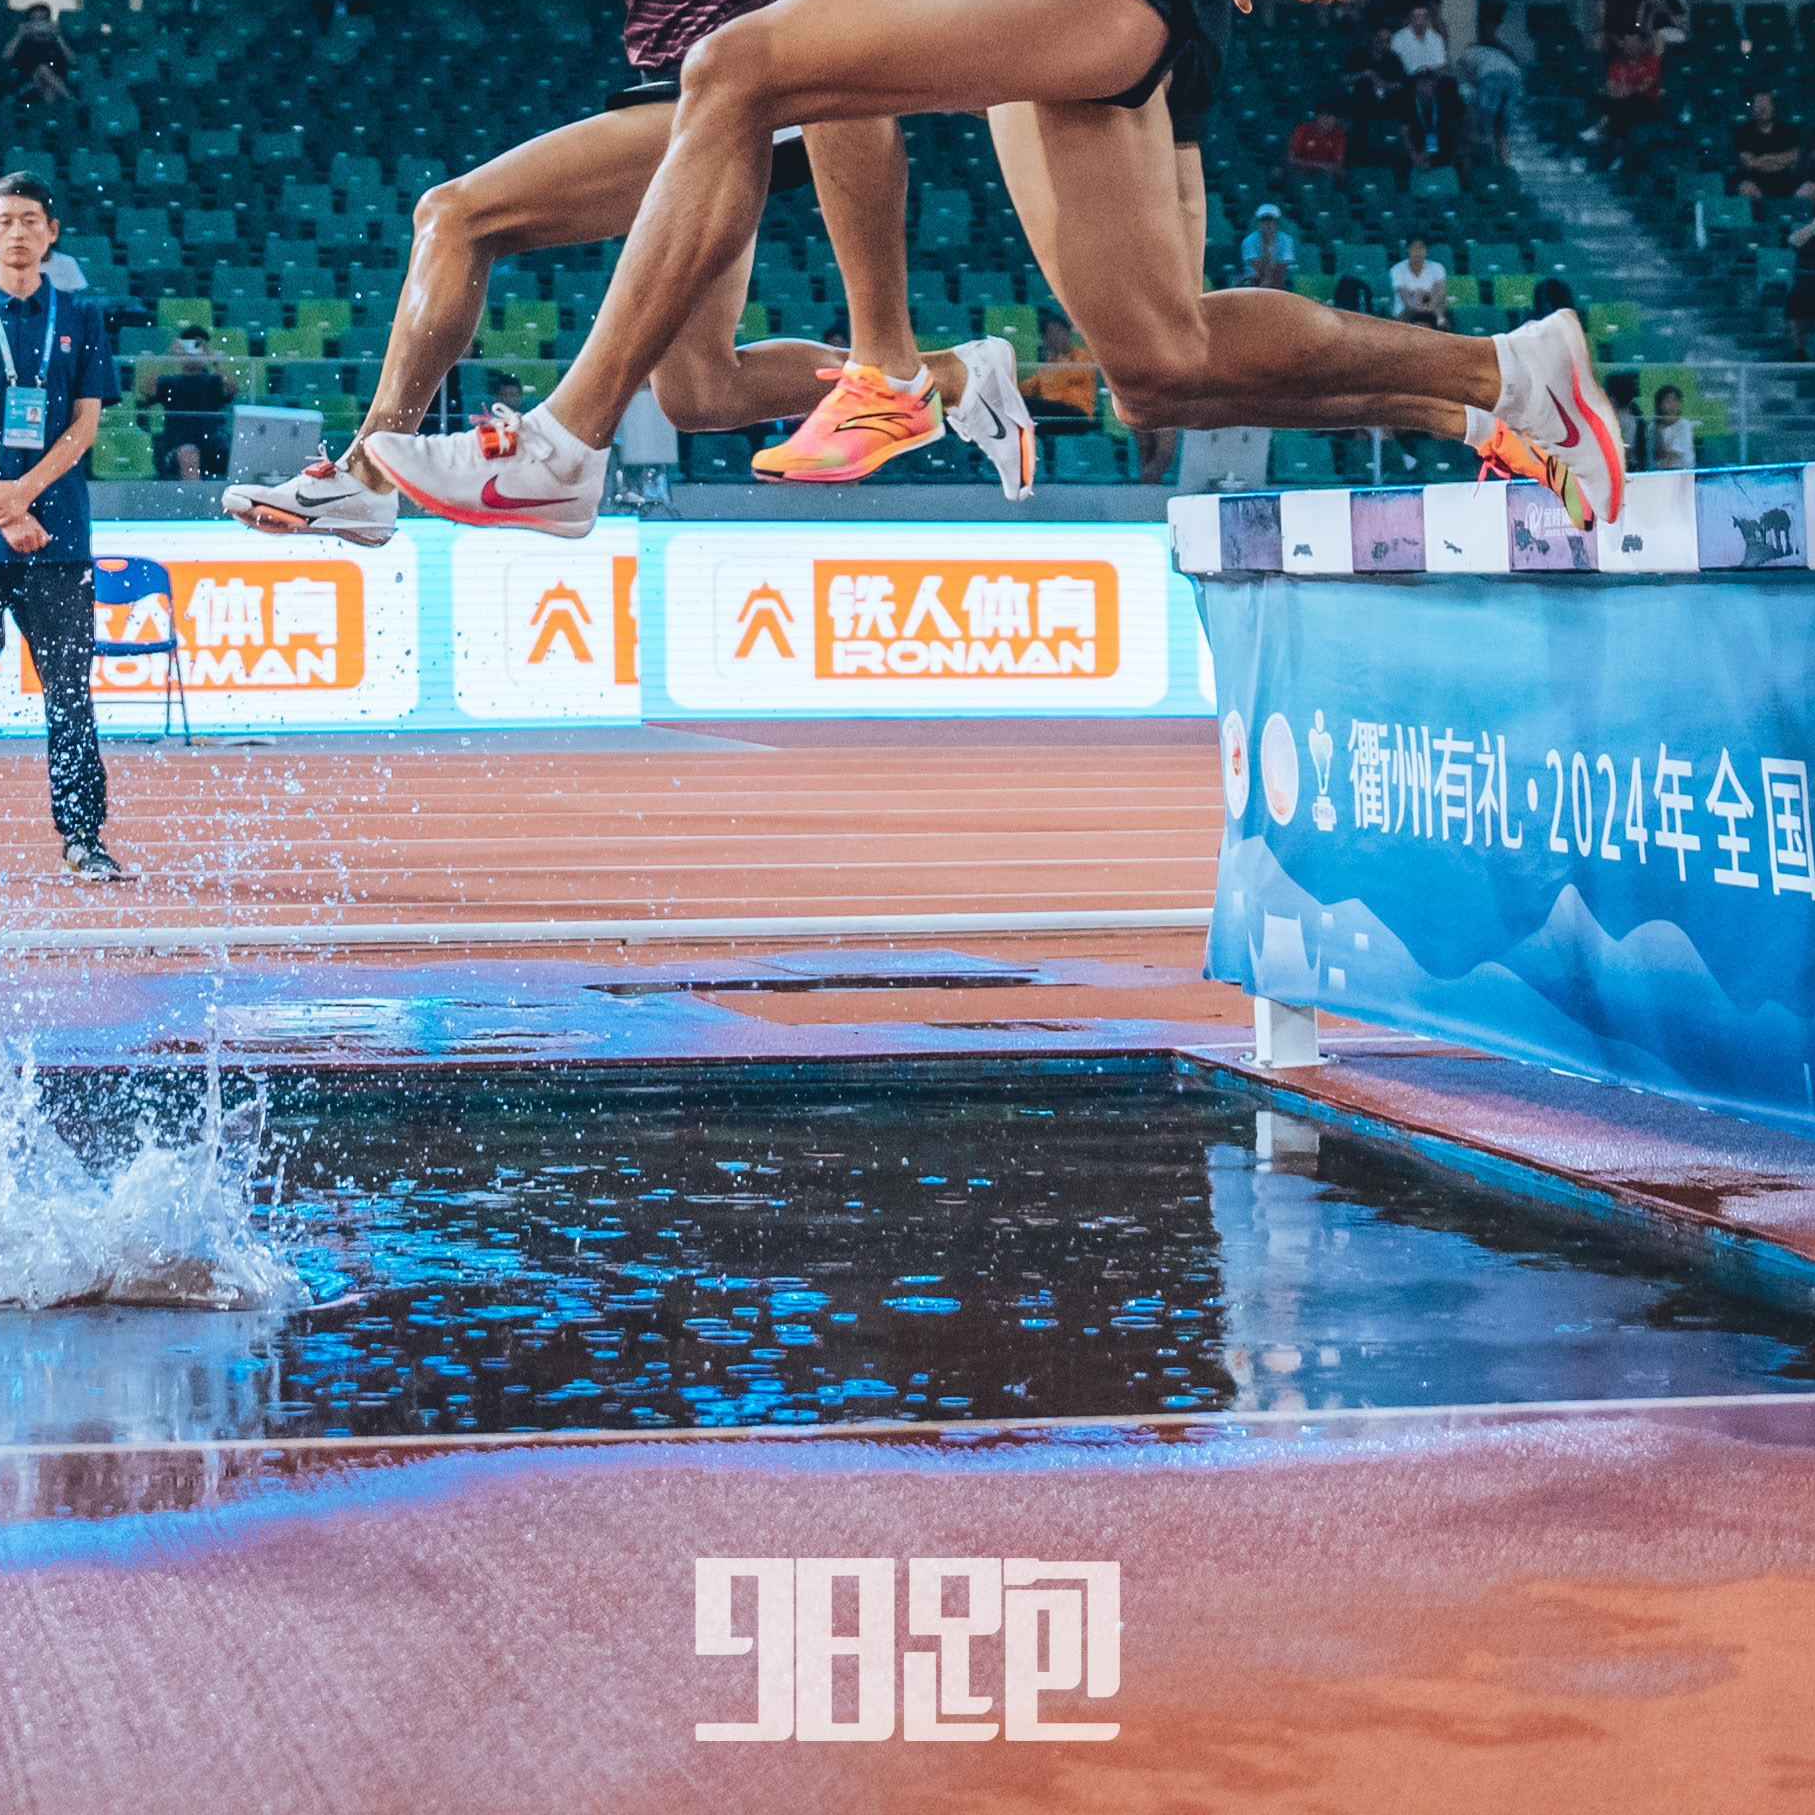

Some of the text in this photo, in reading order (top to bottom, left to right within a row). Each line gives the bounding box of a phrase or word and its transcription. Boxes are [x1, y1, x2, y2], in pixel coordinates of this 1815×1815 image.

[828, 575, 1096, 638] 铁人体育
[832, 640, 1096, 674] IRONMAN
